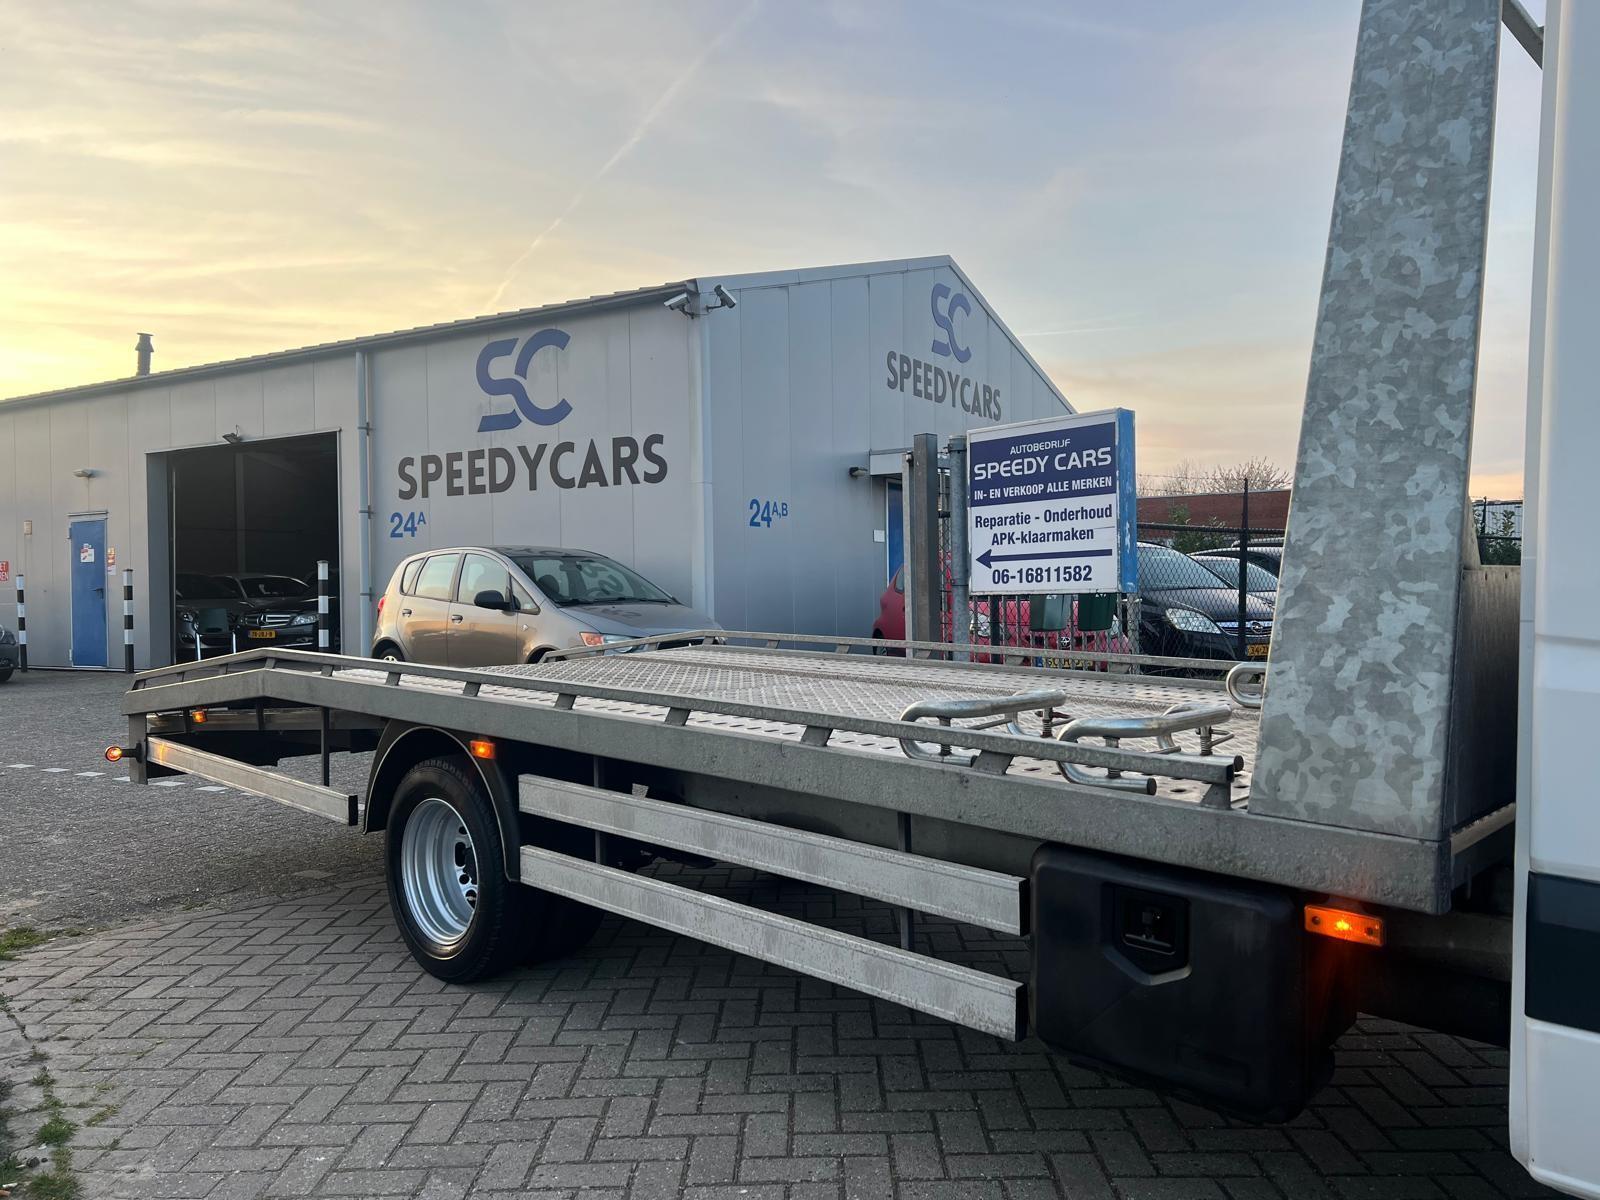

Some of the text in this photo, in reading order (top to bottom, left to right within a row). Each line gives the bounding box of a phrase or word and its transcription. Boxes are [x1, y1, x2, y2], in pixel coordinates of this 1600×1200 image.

[886, 350, 1002, 421] SPEEDYCARS
[1010, 438, 1071, 455] AUTOBEDRIJF
[398, 433, 668, 501] SPEEDYCARS
[974, 447, 1112, 481] SPEEDY CARS
[974, 476, 1112, 500] IN- EN VERKOOP ALLE MERKEN
[975, 511, 1031, 530] Reparatie
[1044, 504, 1113, 523] Onderhoud
[991, 527, 1094, 546] APK-klaarmaken
[992, 565, 1092, 584] 06-16811582
